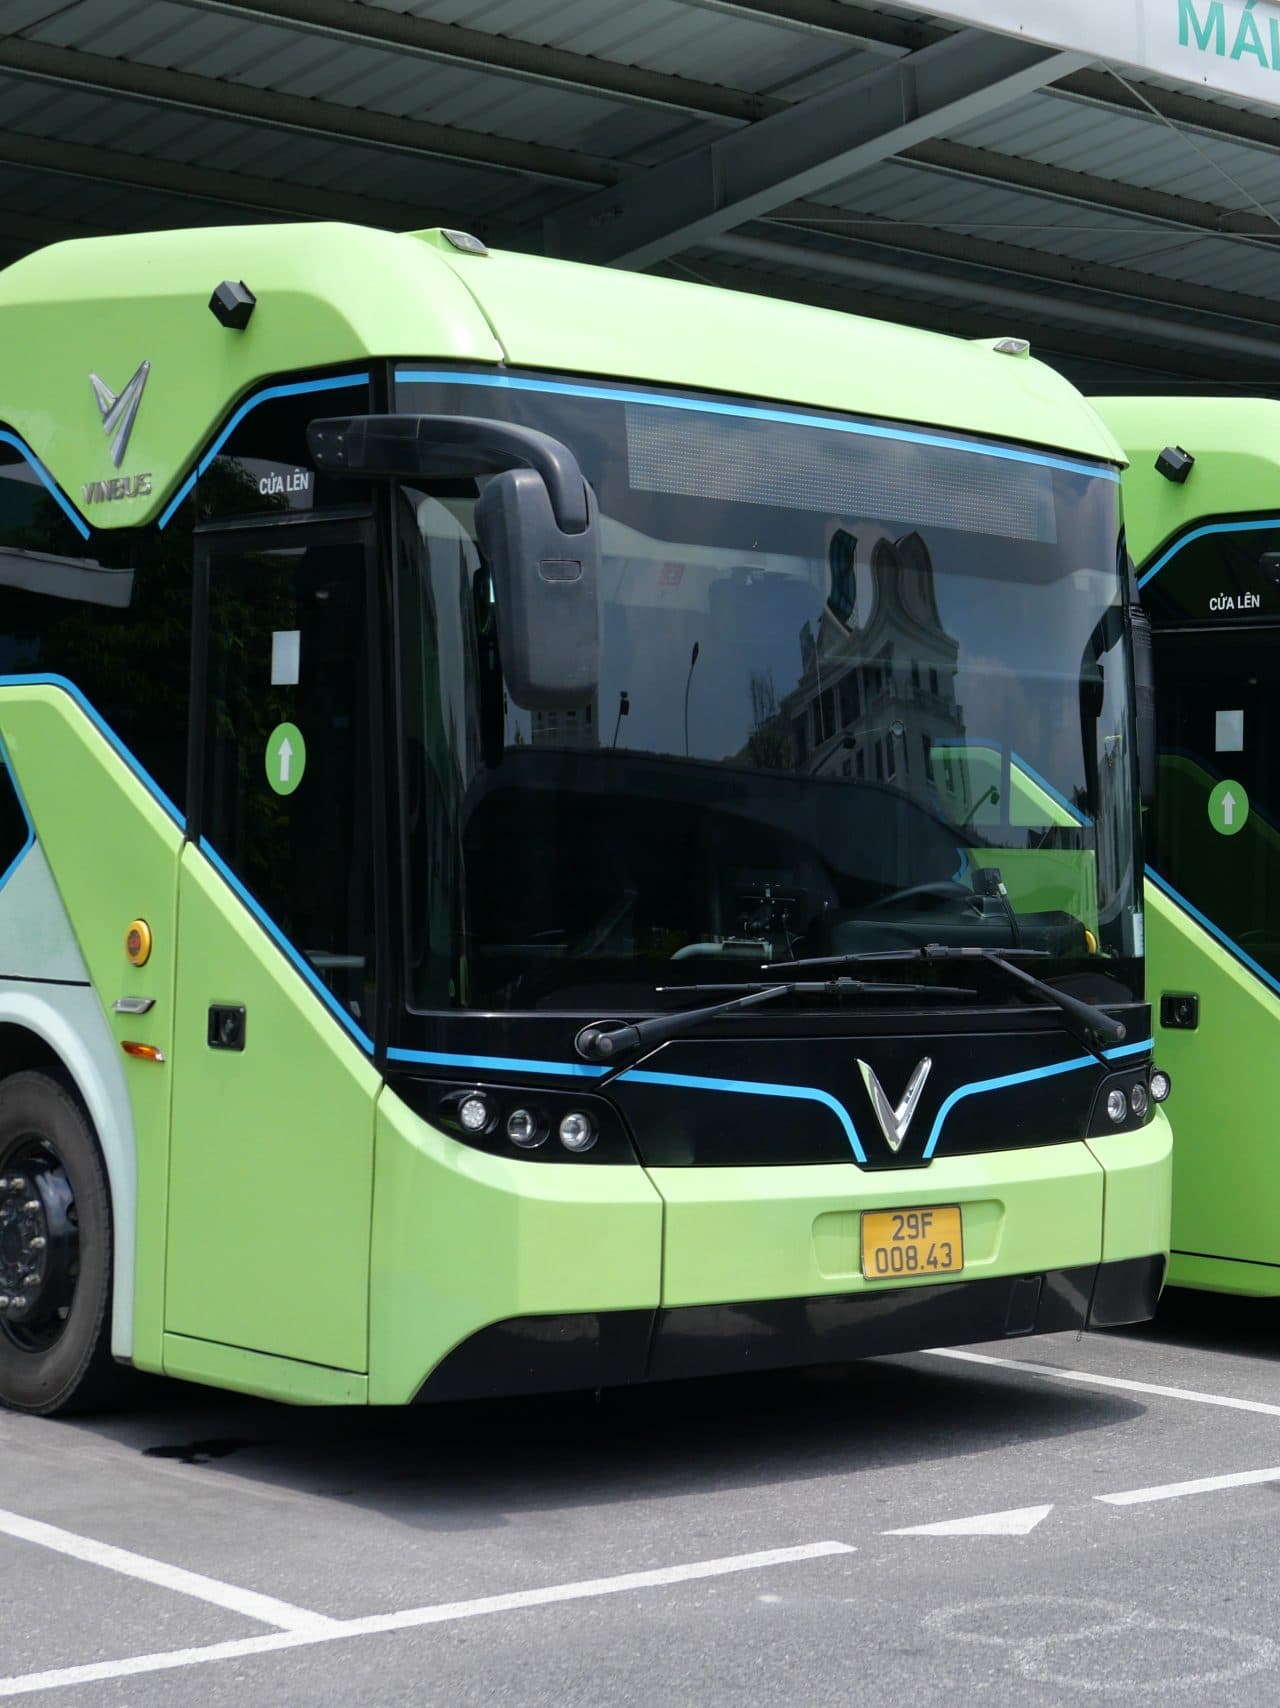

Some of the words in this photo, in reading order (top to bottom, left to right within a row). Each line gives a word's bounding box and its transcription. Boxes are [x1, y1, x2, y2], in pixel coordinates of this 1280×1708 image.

[1178, 0, 1280, 72] MÁI
[82, 473, 153, 505] VINBUS
[259, 471, 284, 495] CỬA
[286, 468, 309, 492] LÊN
[1209, 592, 1235, 611] CỬA
[1237, 591, 1260, 609] LÊN
[892, 1211, 934, 1241] 29F
[875, 1242, 953, 1274] 008.43
